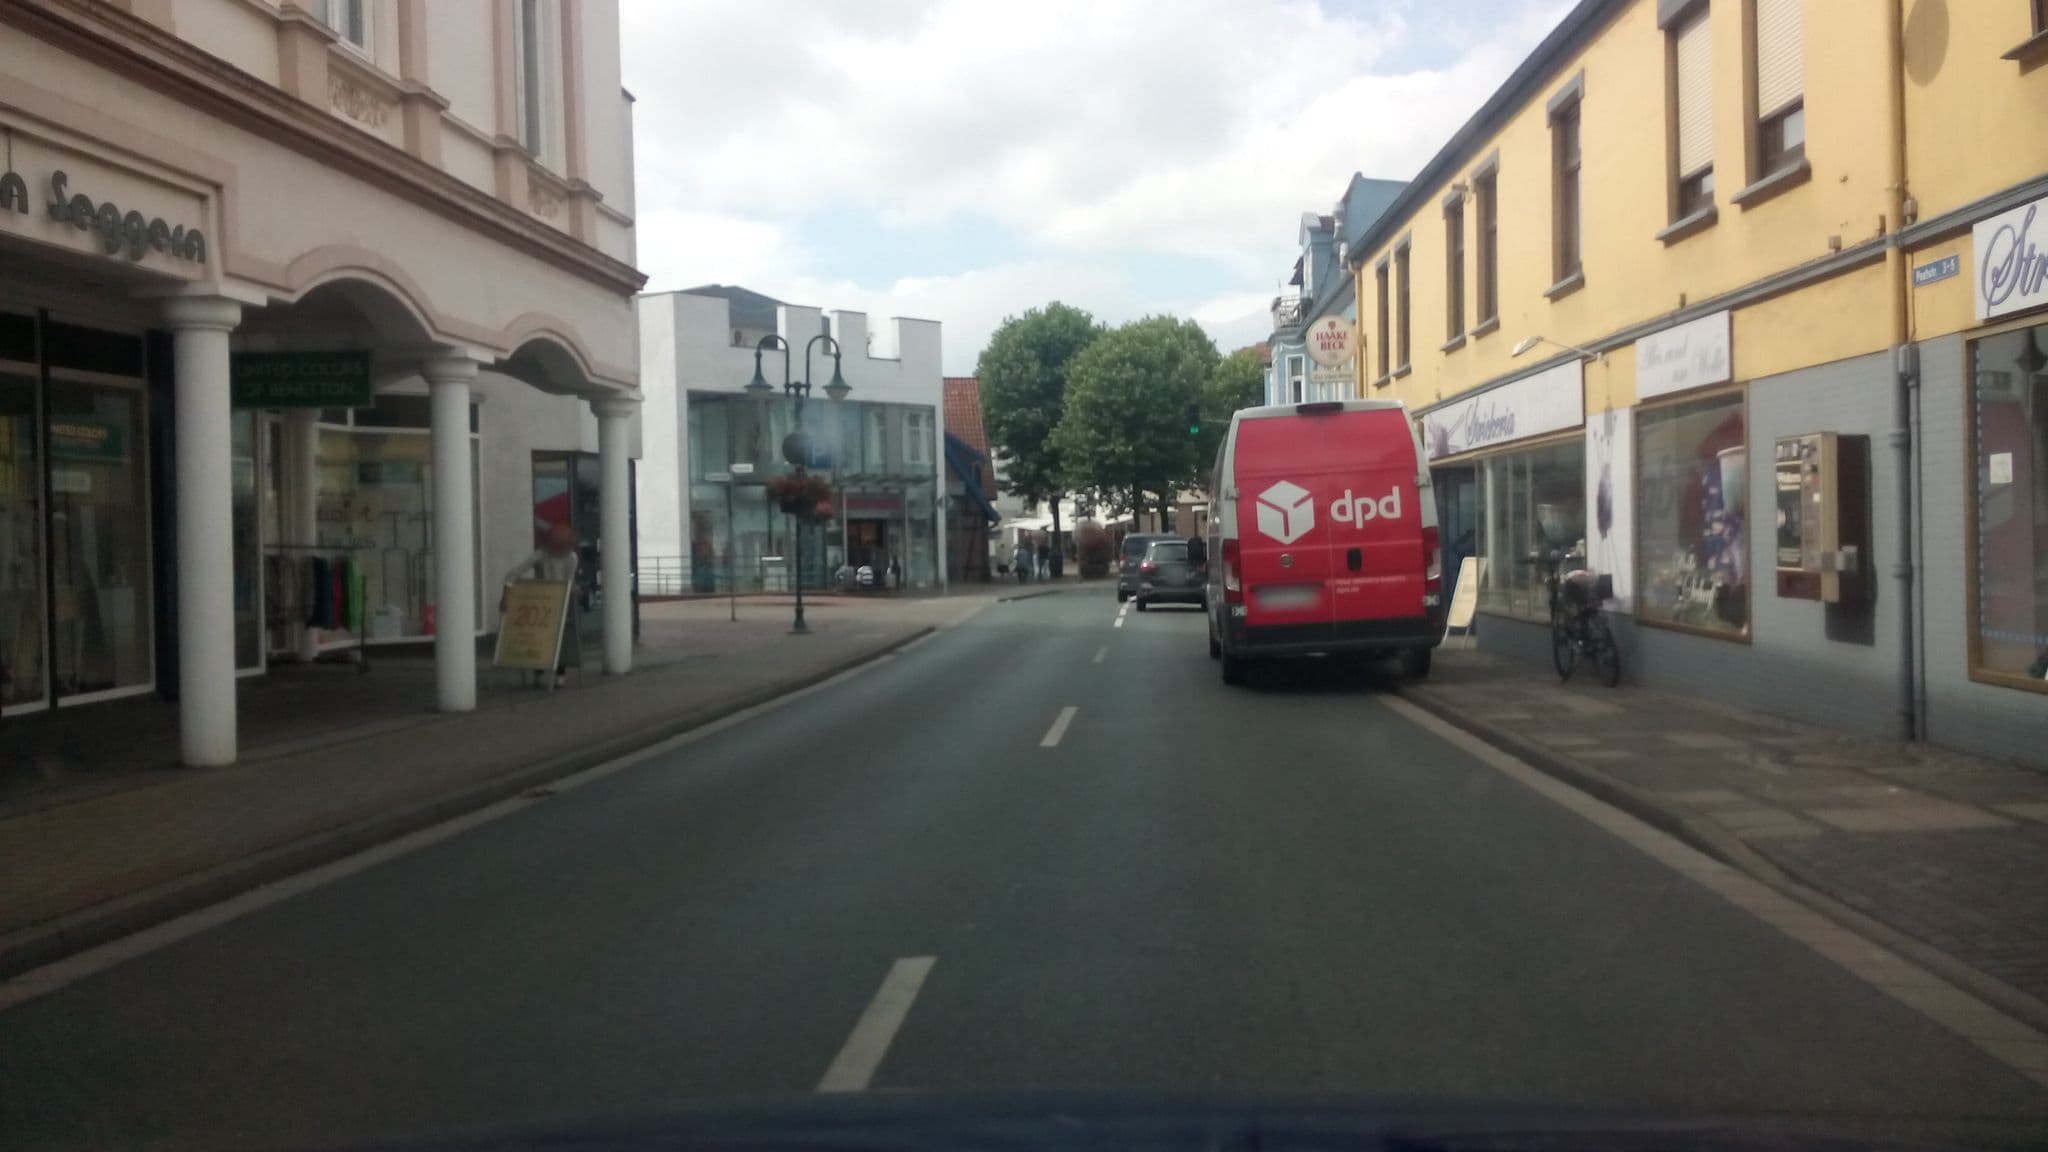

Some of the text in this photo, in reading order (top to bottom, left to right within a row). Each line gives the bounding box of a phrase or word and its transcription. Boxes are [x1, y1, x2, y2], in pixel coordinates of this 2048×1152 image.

[48, 170, 206, 263] Seggern
[1320, 340, 1345, 352] BECK
[1330, 485, 1402, 529] dpd
